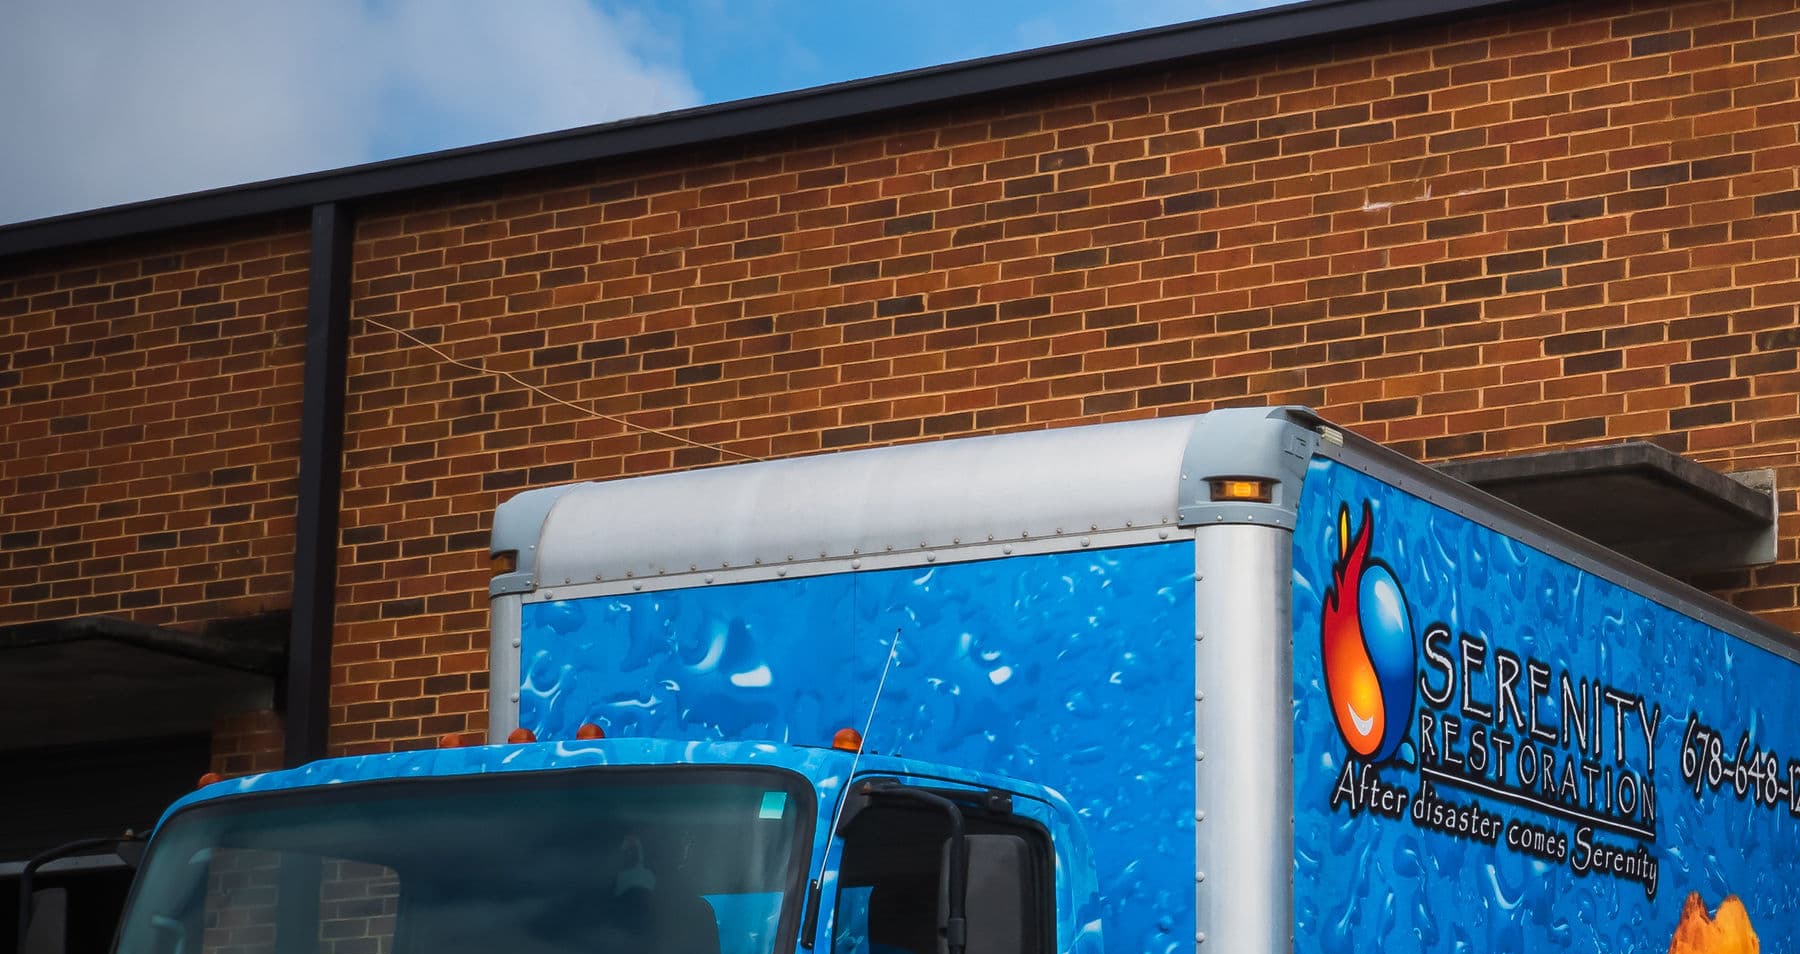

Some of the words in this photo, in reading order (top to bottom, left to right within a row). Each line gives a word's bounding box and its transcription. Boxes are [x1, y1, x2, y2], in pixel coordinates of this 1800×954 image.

[1421, 629, 1660, 770] SERENITY
[1332, 760, 1407, 812] After
[1413, 780, 1501, 840] disaster
[1508, 825, 1566, 858] comes
[1571, 826, 1657, 895] Serenity
[1421, 714, 1655, 821] RESTORATION
